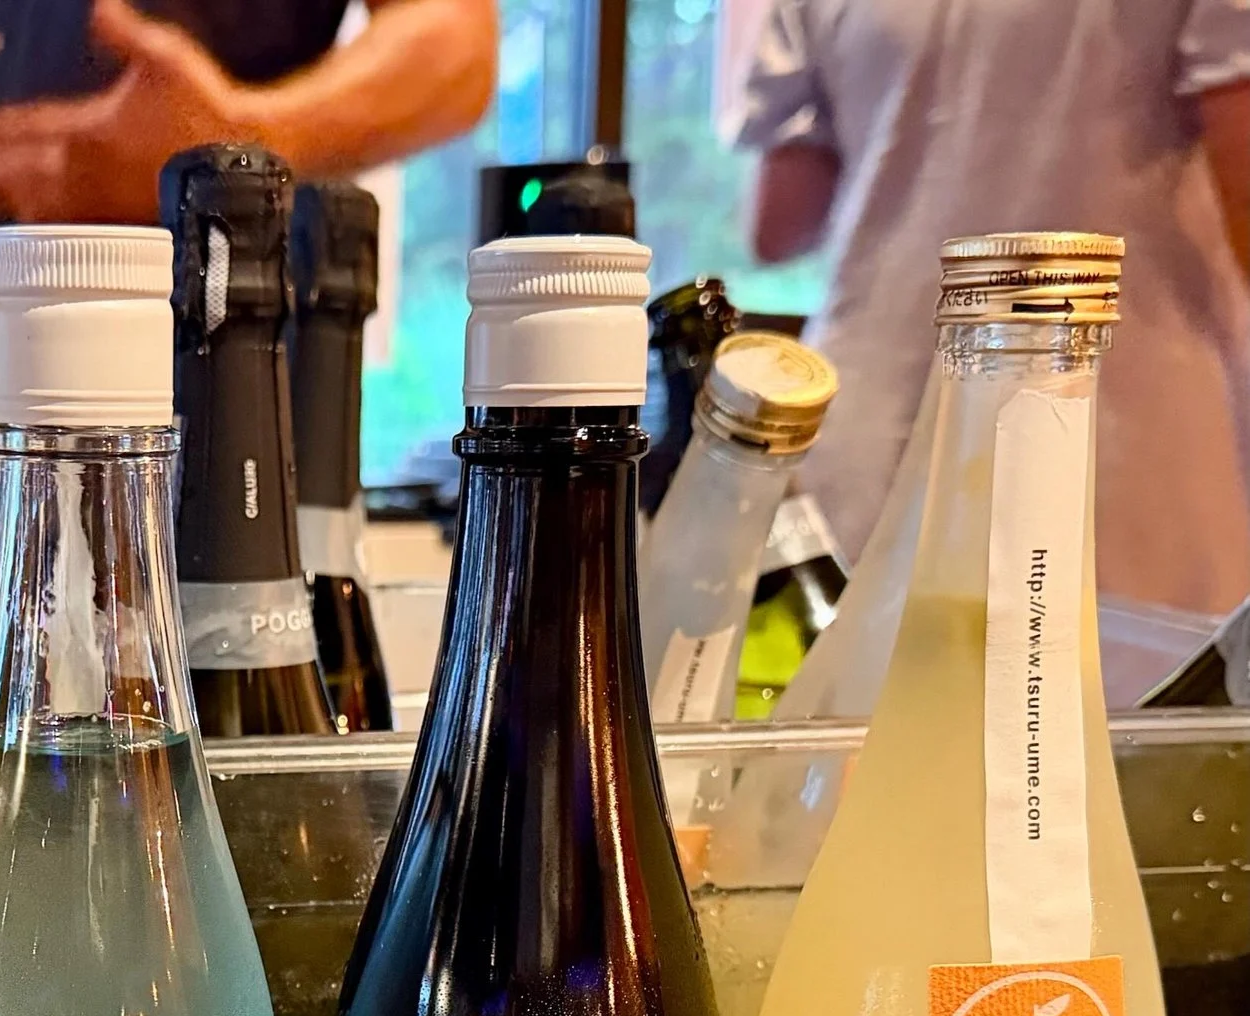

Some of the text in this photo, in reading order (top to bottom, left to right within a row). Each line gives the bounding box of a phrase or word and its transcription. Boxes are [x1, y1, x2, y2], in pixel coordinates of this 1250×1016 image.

[989, 270, 1029, 286] OPEN
[1034, 270, 1068, 286] THIS
[1026, 549, 1048, 841] http://www.tsuru-ume.com
